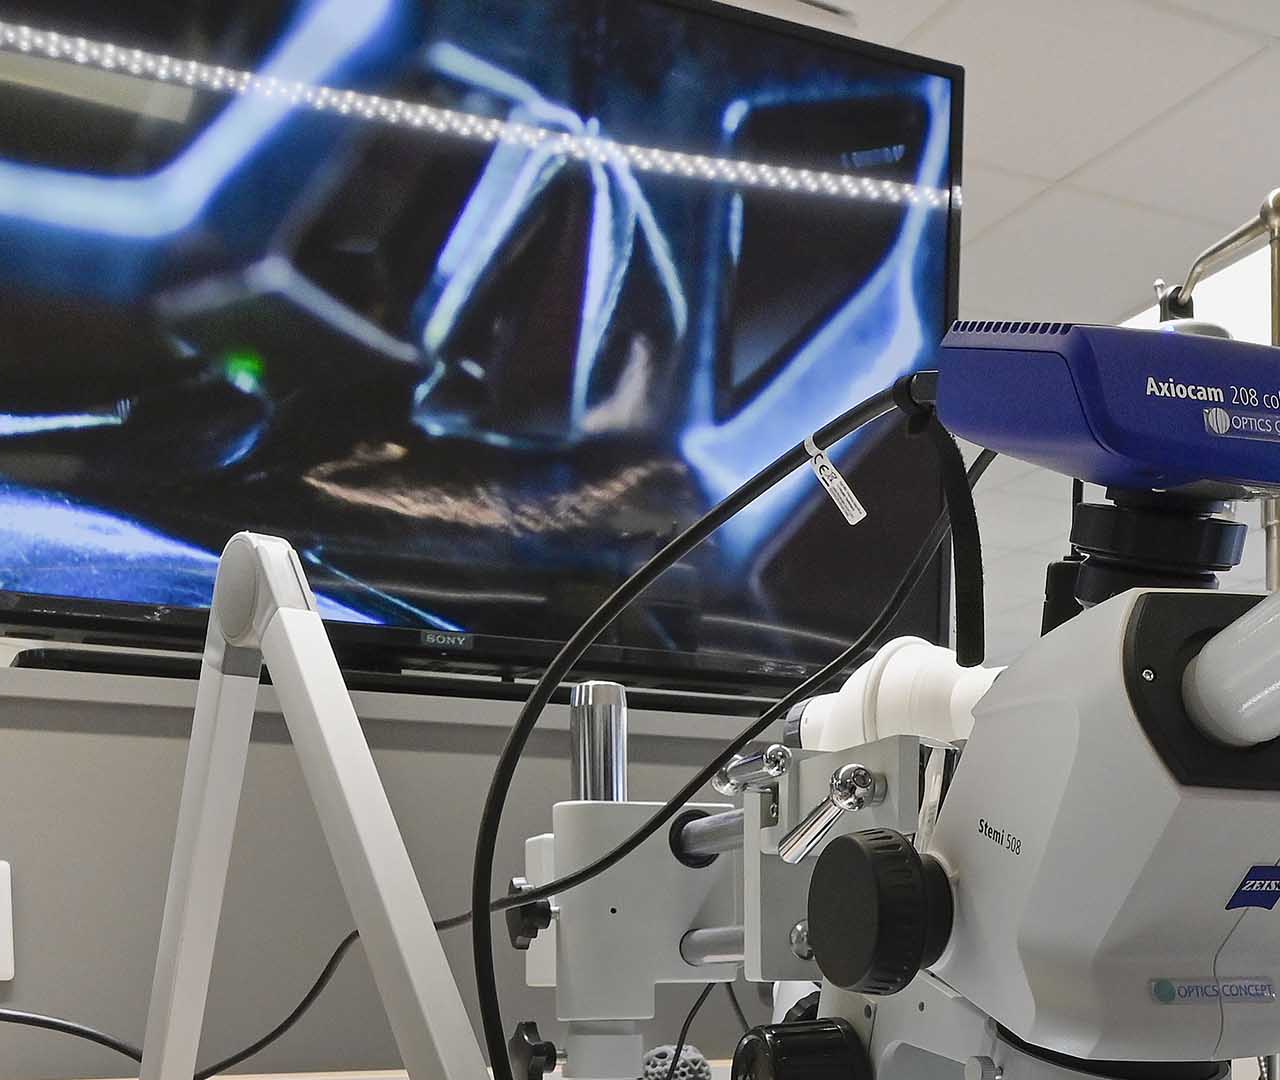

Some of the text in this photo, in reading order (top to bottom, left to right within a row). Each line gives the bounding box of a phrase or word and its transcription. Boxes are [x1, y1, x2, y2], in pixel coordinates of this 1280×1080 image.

[1146, 377, 1224, 402] Axiocam
[1230, 385, 1259, 407] 208
[1231, 415, 1272, 433] OPTICS
[426, 635, 465, 645] SONY
[979, 818, 1022, 855] Stemi 508
[1177, 984, 1273, 998] OPTICS CONCEPT
